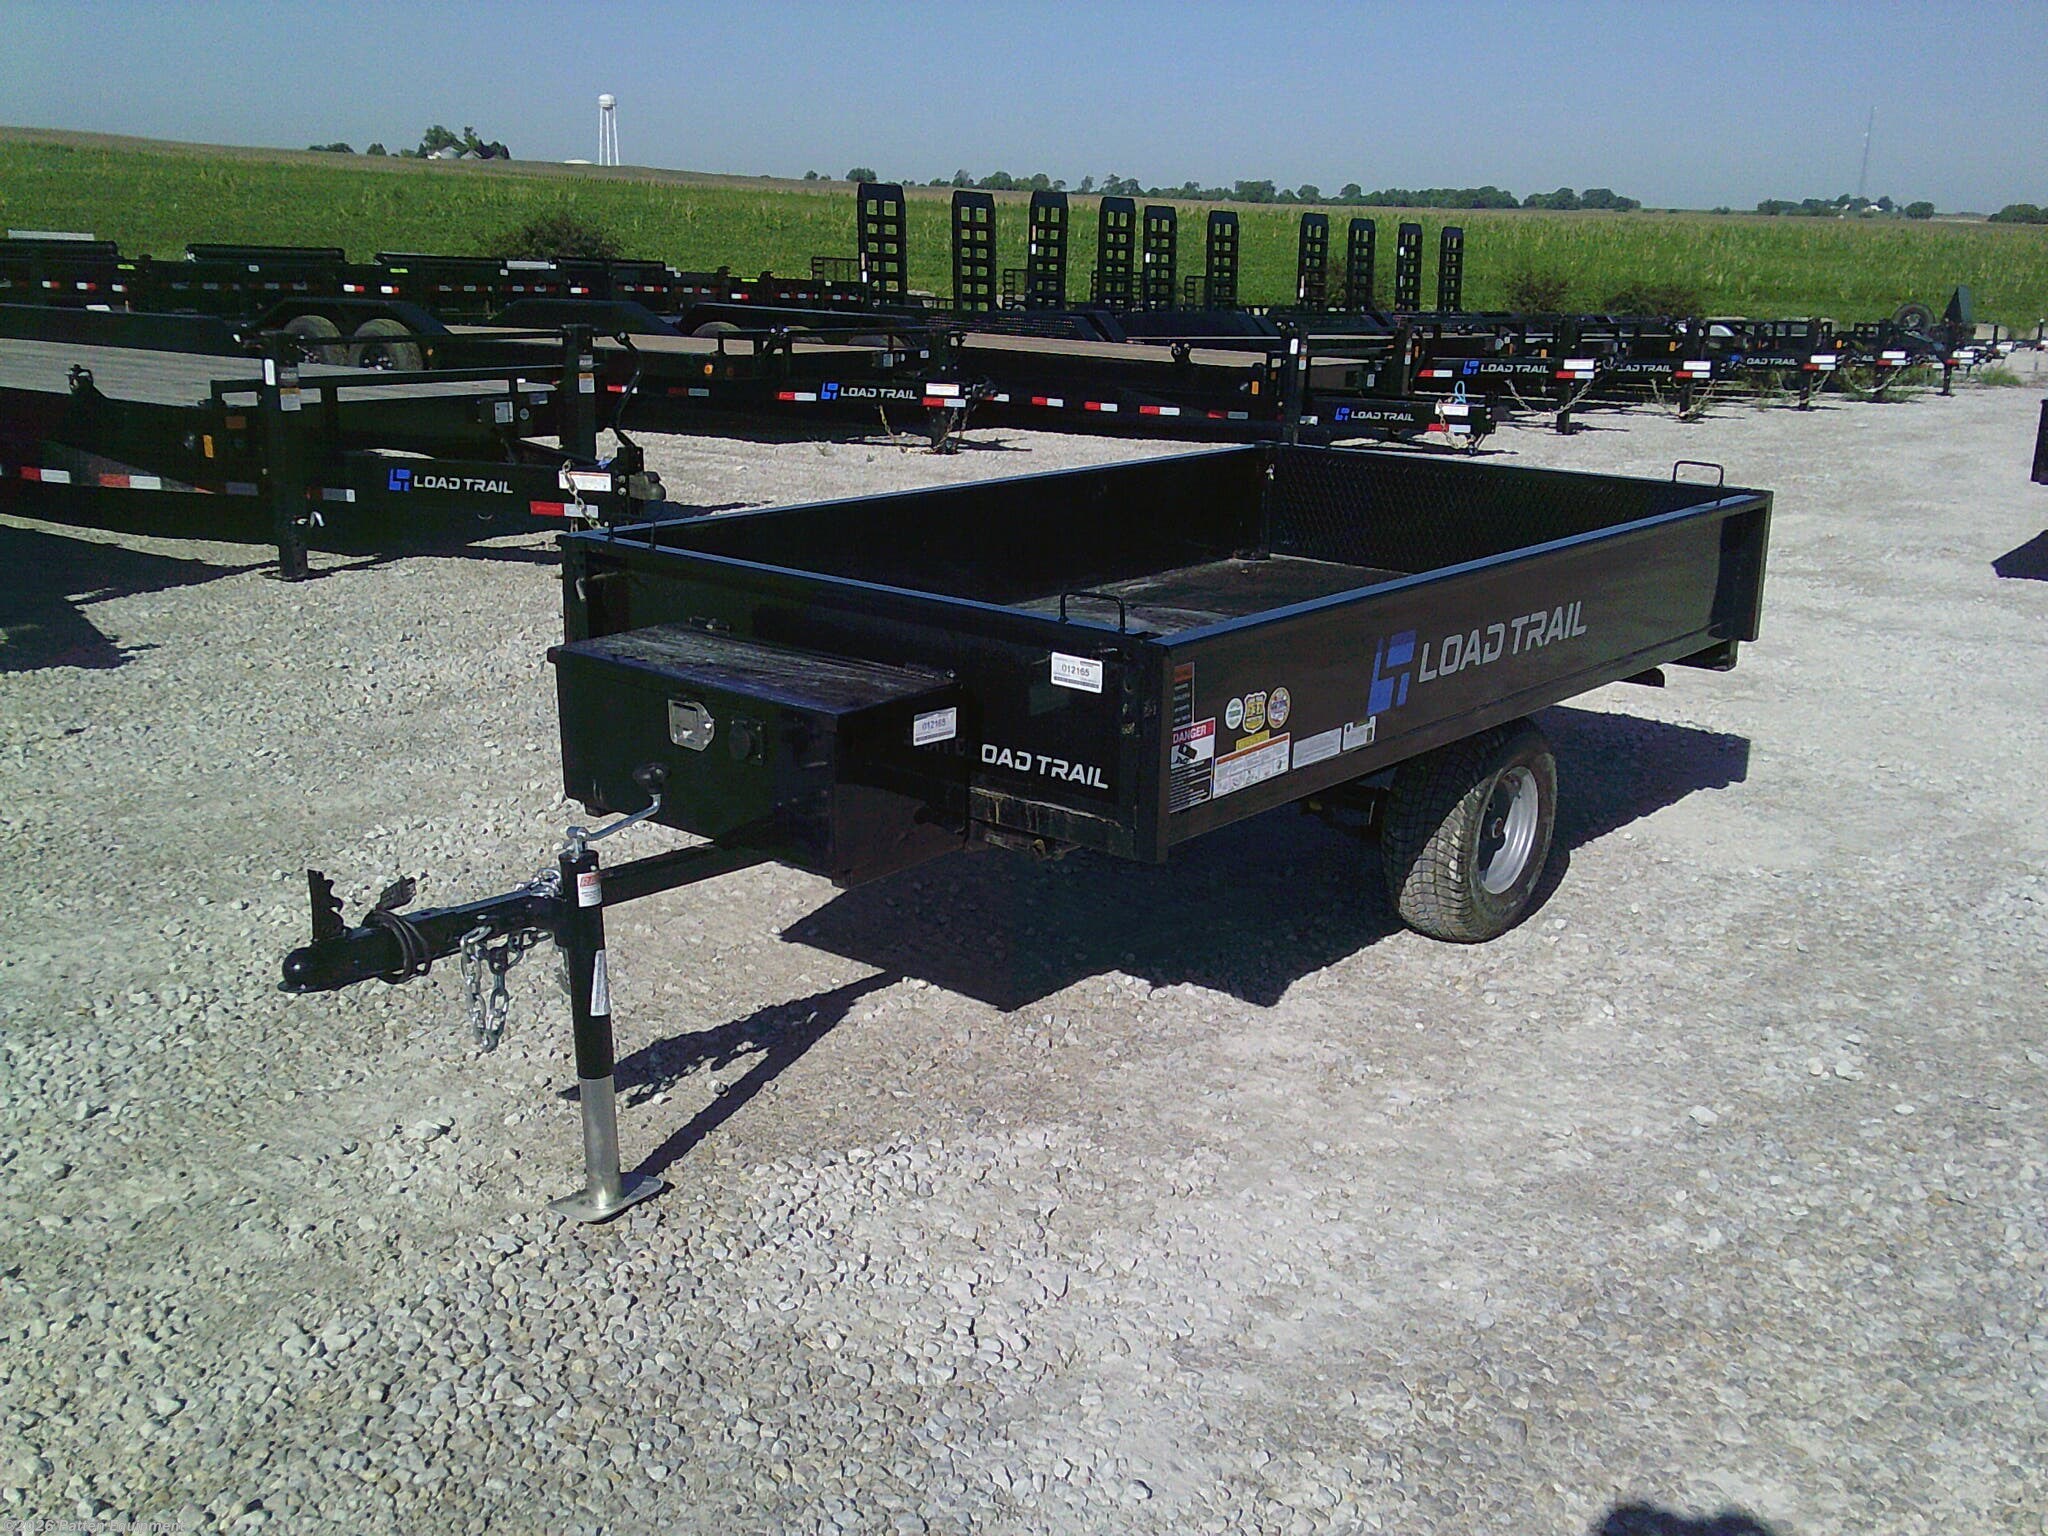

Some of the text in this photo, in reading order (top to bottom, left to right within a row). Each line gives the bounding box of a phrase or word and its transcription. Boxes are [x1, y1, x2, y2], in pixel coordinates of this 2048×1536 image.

[1746, 357, 1798, 366] OAD TRAIL
[1480, 363, 1550, 374] LOAD TRAIL
[1642, 364, 1673, 373] TRAIL
[840, 387, 917, 400] LOAD TRAIL
[1351, 410, 1415, 422] LOAD TRAIL
[414, 475, 514, 494] LOAD TRAIL
[1418, 600, 1588, 683] LOAD TRAIL
[1061, 663, 1090, 677] 012165
[1172, 724, 1207, 744] DANGER
[981, 743, 1032, 772] OAD
[1036, 754, 1109, 790] TRAIL
